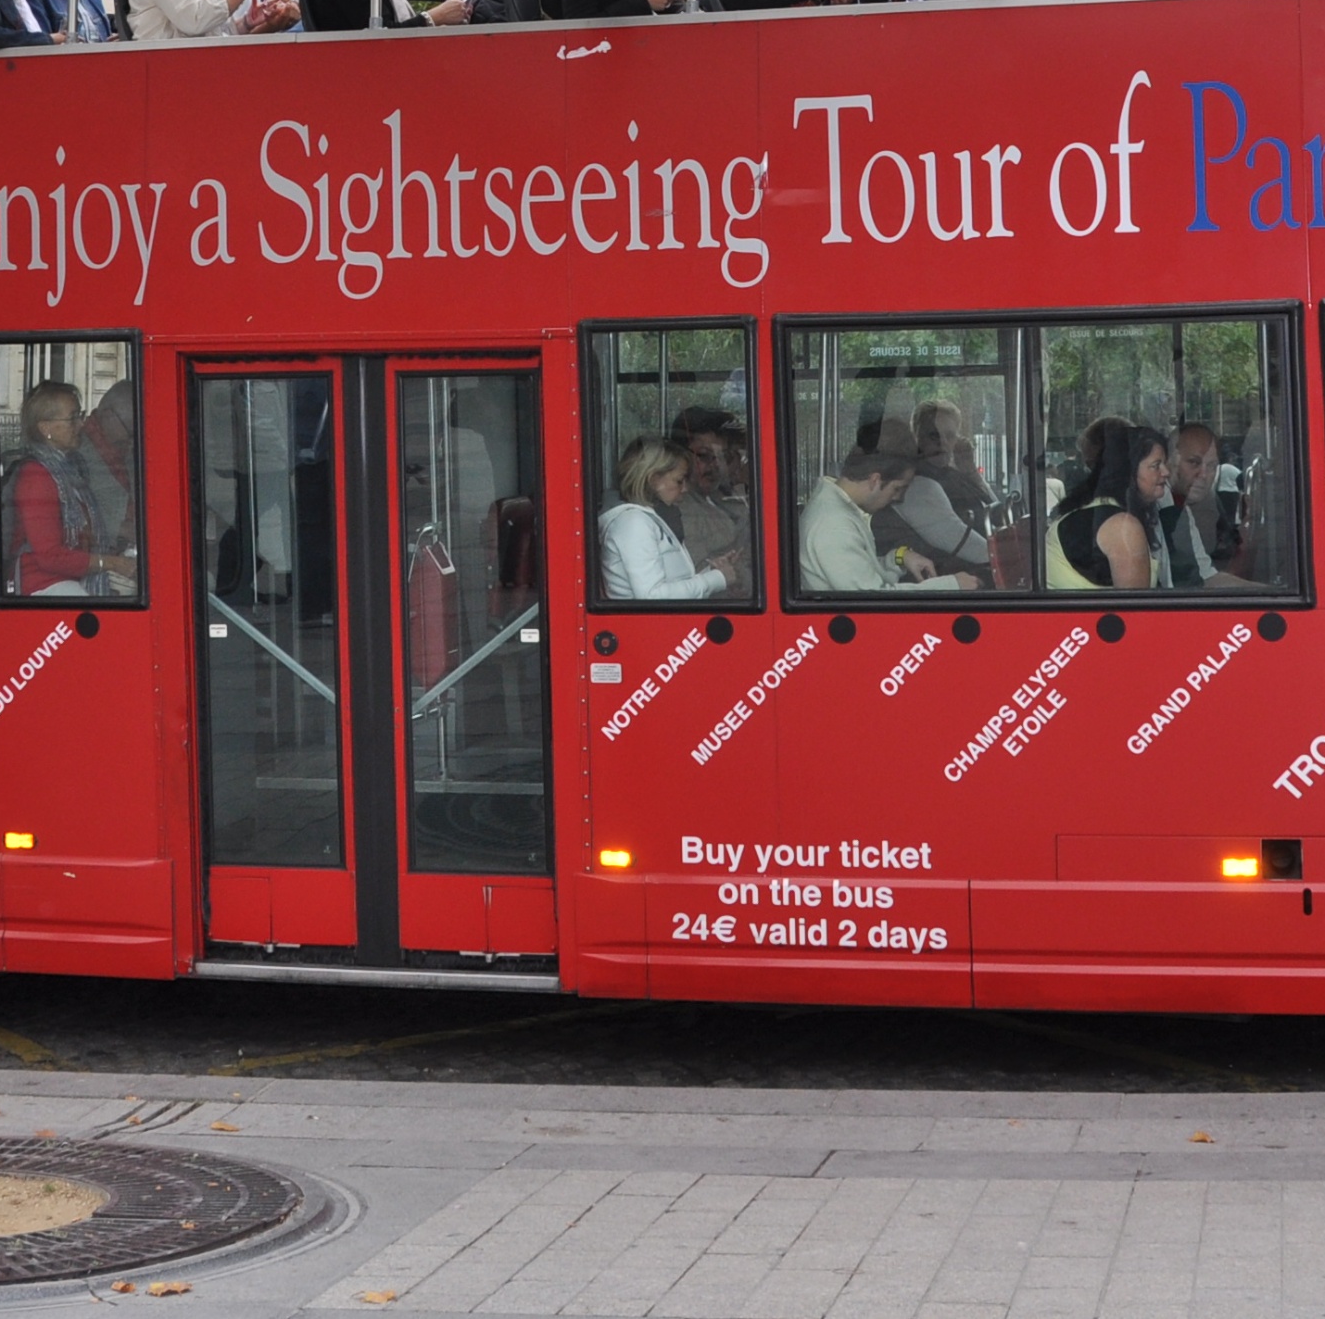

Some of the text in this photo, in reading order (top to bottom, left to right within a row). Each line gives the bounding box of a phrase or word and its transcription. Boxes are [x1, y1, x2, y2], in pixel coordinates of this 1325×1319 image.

[189, 177, 236, 267] a
[258, 108, 770, 301] Sightseeing
[792, 93, 1022, 245] Tour
[1049, 69, 1153, 237] of
[9, 619, 74, 690] LOUVRE
[600, 677, 661, 741] NOTRE
[654, 627, 708, 684] DAME
[879, 631, 943, 698] OPERA
[1126, 622, 1253, 756] GRAND PALAIS
[690, 625, 821, 766] MUSEE D'ORSAY
[943, 625, 1091, 782] CHAMPS ELYSEES
[1002, 688, 1068, 758] ETOILE
[681, 835, 932, 873] Buy your ticket
[718, 878, 894, 909] on the bus
[672, 912, 948, 954] 24€ valid 2 days
